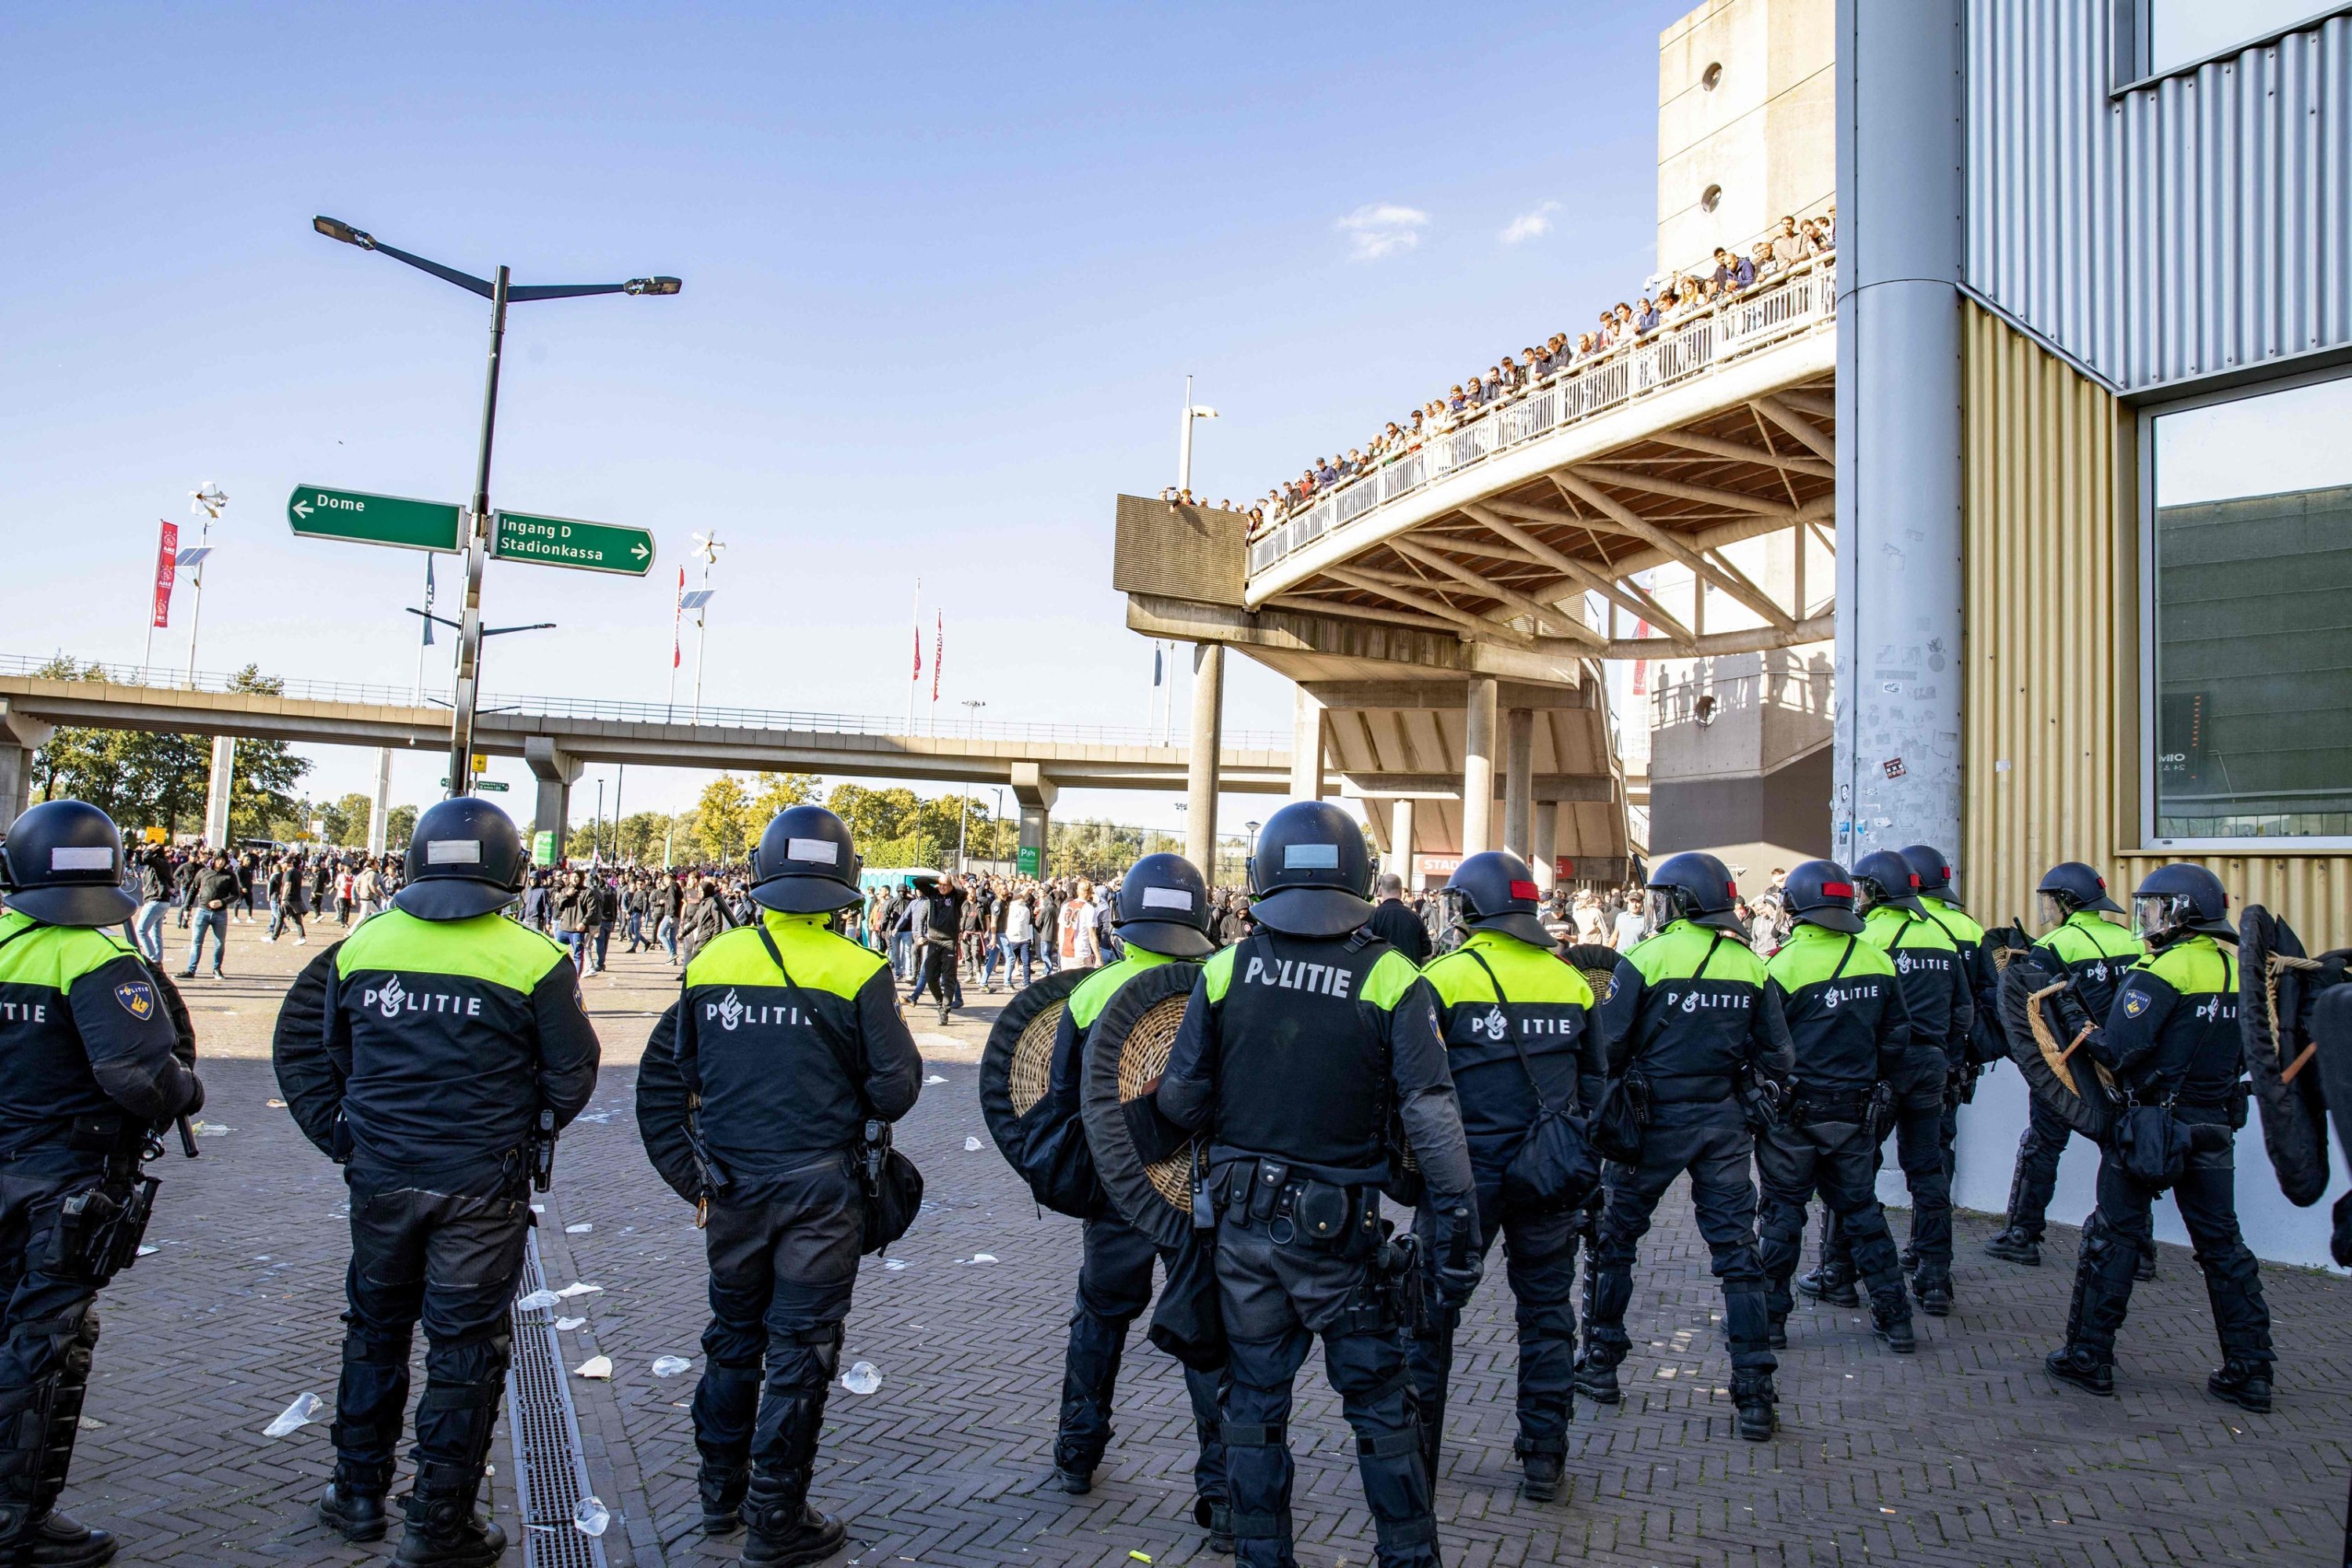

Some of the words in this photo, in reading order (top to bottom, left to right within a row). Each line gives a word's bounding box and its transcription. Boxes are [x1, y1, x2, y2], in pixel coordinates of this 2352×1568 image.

[318, 494, 365, 511] Dome
[503, 518, 555, 539] Ingang
[561, 526, 572, 537] D
[501, 537, 603, 561] Stadionkassa
[1893, 955, 1949, 974] OLITIE
[363, 983, 481, 1018] POLITIE
[1472, 1014, 1570, 1040] POITIE
